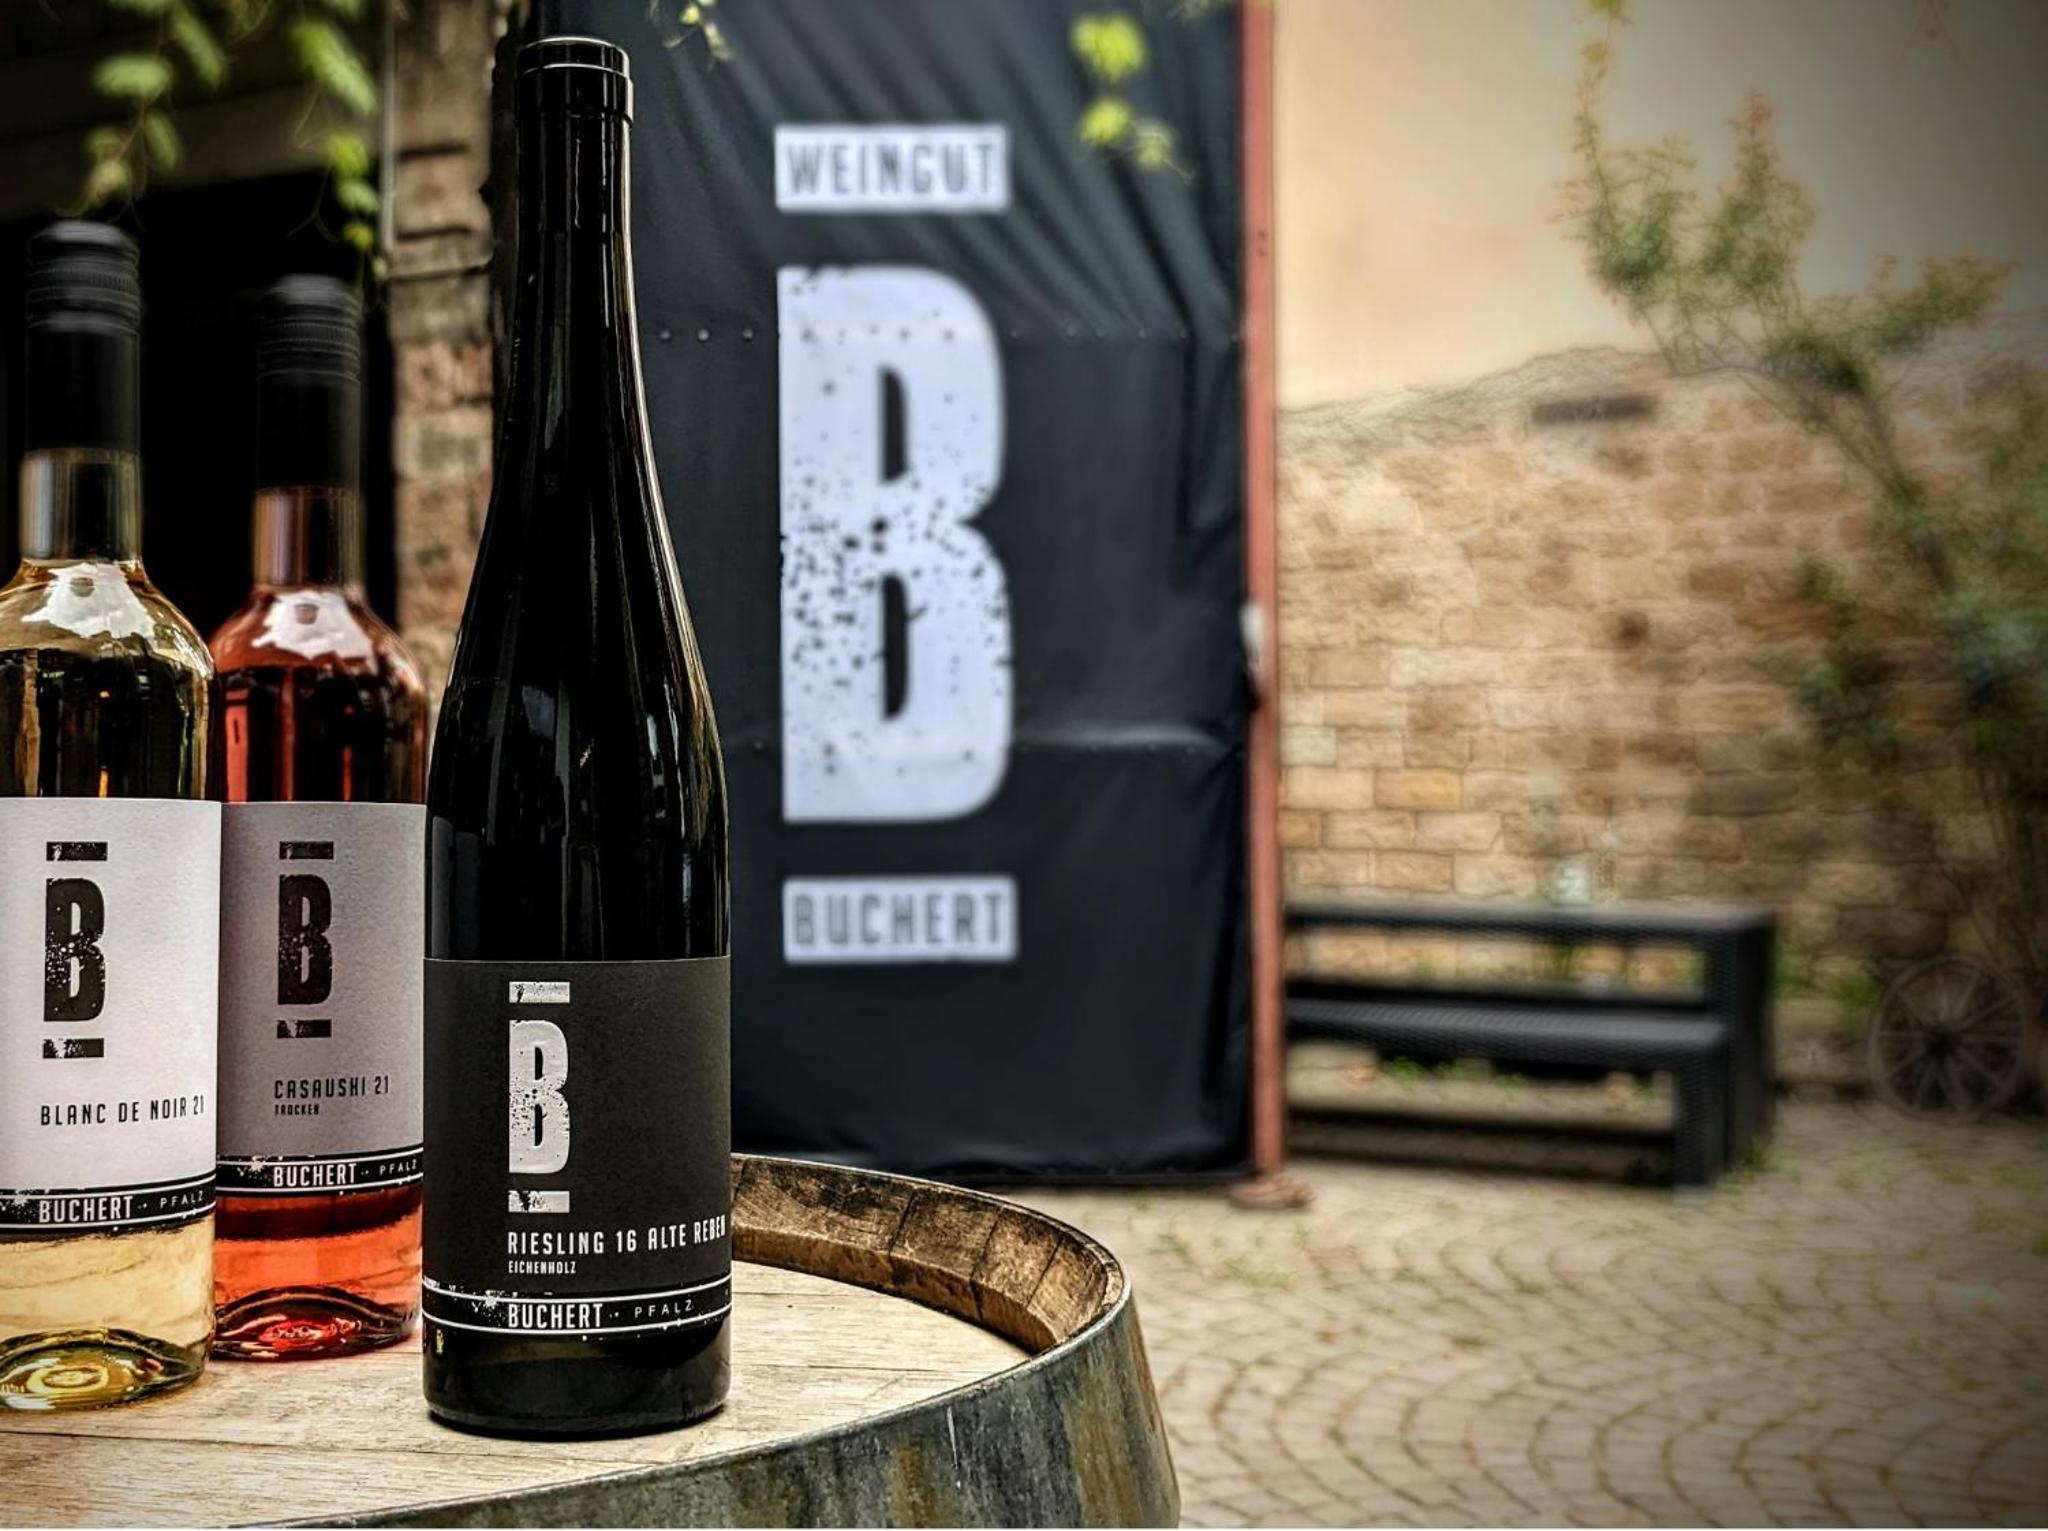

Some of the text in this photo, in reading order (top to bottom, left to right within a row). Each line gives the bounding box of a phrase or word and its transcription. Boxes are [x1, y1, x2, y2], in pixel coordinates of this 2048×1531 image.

[786, 144, 993, 195] WEINGUT
[776, 265, 1014, 824] B
[793, 893, 1003, 945] BUCHERT
[45, 877, 106, 1022] B
[277, 874, 332, 1005] B
[274, 1075, 389, 1099] CASAUSHI 21
[508, 1019, 570, 1174] B
[40, 1094, 205, 1126] BLANC DE NOIR 21
[274, 1103, 320, 1116] TROCKEN
[273, 1158, 418, 1188] BUCHERT PFALZ
[38, 1189, 204, 1224] BUCHERT PFALZ
[507, 1231, 604, 1255] RIESLING
[616, 1229, 637, 1253] 16
[648, 1223, 687, 1250] ALTE
[508, 1260, 577, 1275] EICHENHOLZ
[507, 1299, 693, 1330] BUCHERT PFALZ
